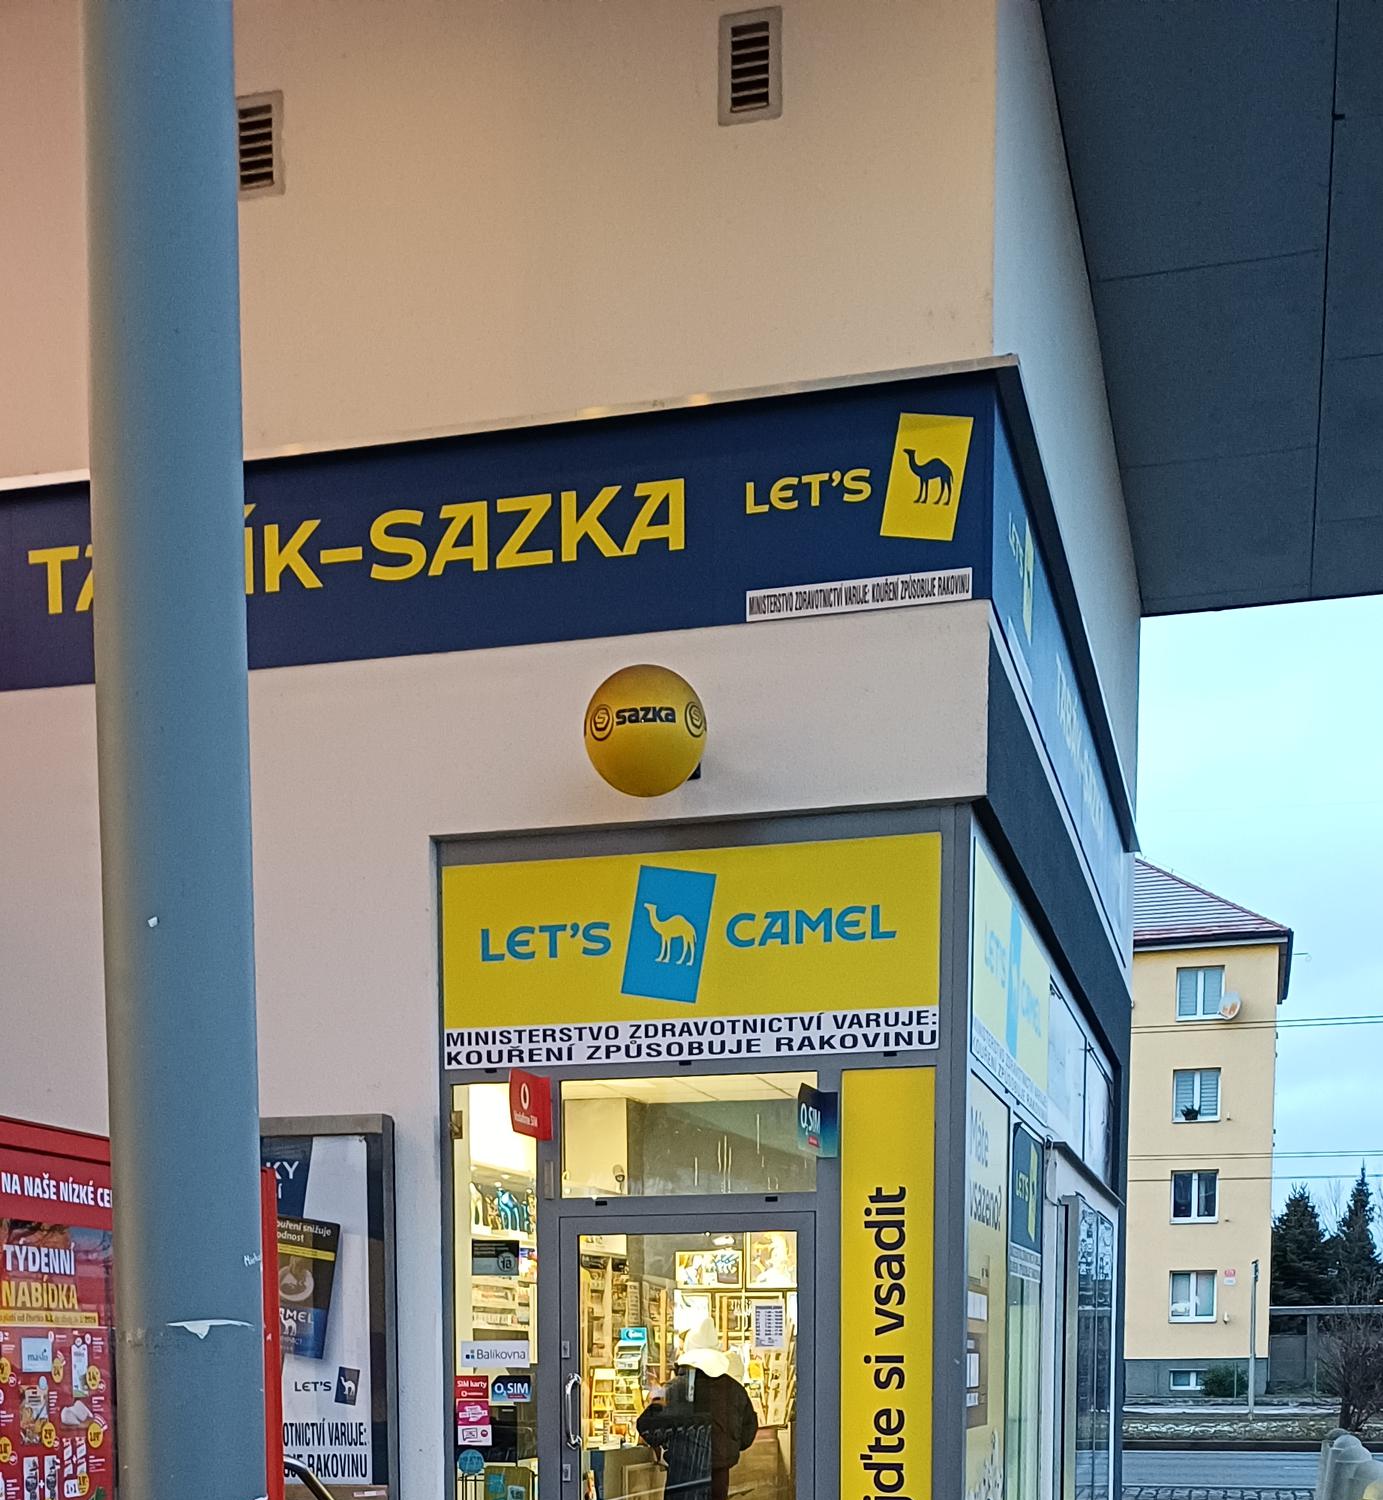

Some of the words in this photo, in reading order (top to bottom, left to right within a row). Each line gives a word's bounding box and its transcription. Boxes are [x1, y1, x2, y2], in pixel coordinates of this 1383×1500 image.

[746, 469, 872, 514] LET'S
[749, 592, 794, 616] MINISTERSTVO
[795, 583, 843, 611] ZDRAVOTNICTVÍ
[844, 583, 871, 607] VARUJE:
[872, 577, 899, 603] KOUŘENÍ
[900, 574, 936, 600] ZPŮSOBUJE
[937, 572, 970, 597] RAKOVINU
[480, 922, 612, 962] LET'S
[726, 904, 898, 949] CAMEL
[446, 1025, 619, 1047] MINISTERSTVO
[629, 1012, 824, 1039] ZDRAVOTNICTVÍ
[833, 1010, 937, 1030] VARUJE:
[447, 1043, 575, 1066] KOUŘENÍ
[586, 1038, 761, 1060] ZPŮSOBUJE
[775, 1030, 937, 1052] RAKOVINU
[1, 1172, 21, 1195] NA
[24, 1172, 57, 1200] NAŠE
[60, 1176, 95, 1206] NÍZKÉ
[97, 1187, 112, 1208] CE
[3, 1237, 75, 1275] TÝDENNÍ
[864, 1186, 906, 1336] vsadit
[2, 1274, 78, 1309] NABÍDKA
[294, 1381, 332, 1392] LET'S
[507, 1383, 528, 1394] SIM
[864, 1355, 905, 1390] si
[328, 1422, 367, 1446] VARUJE:
